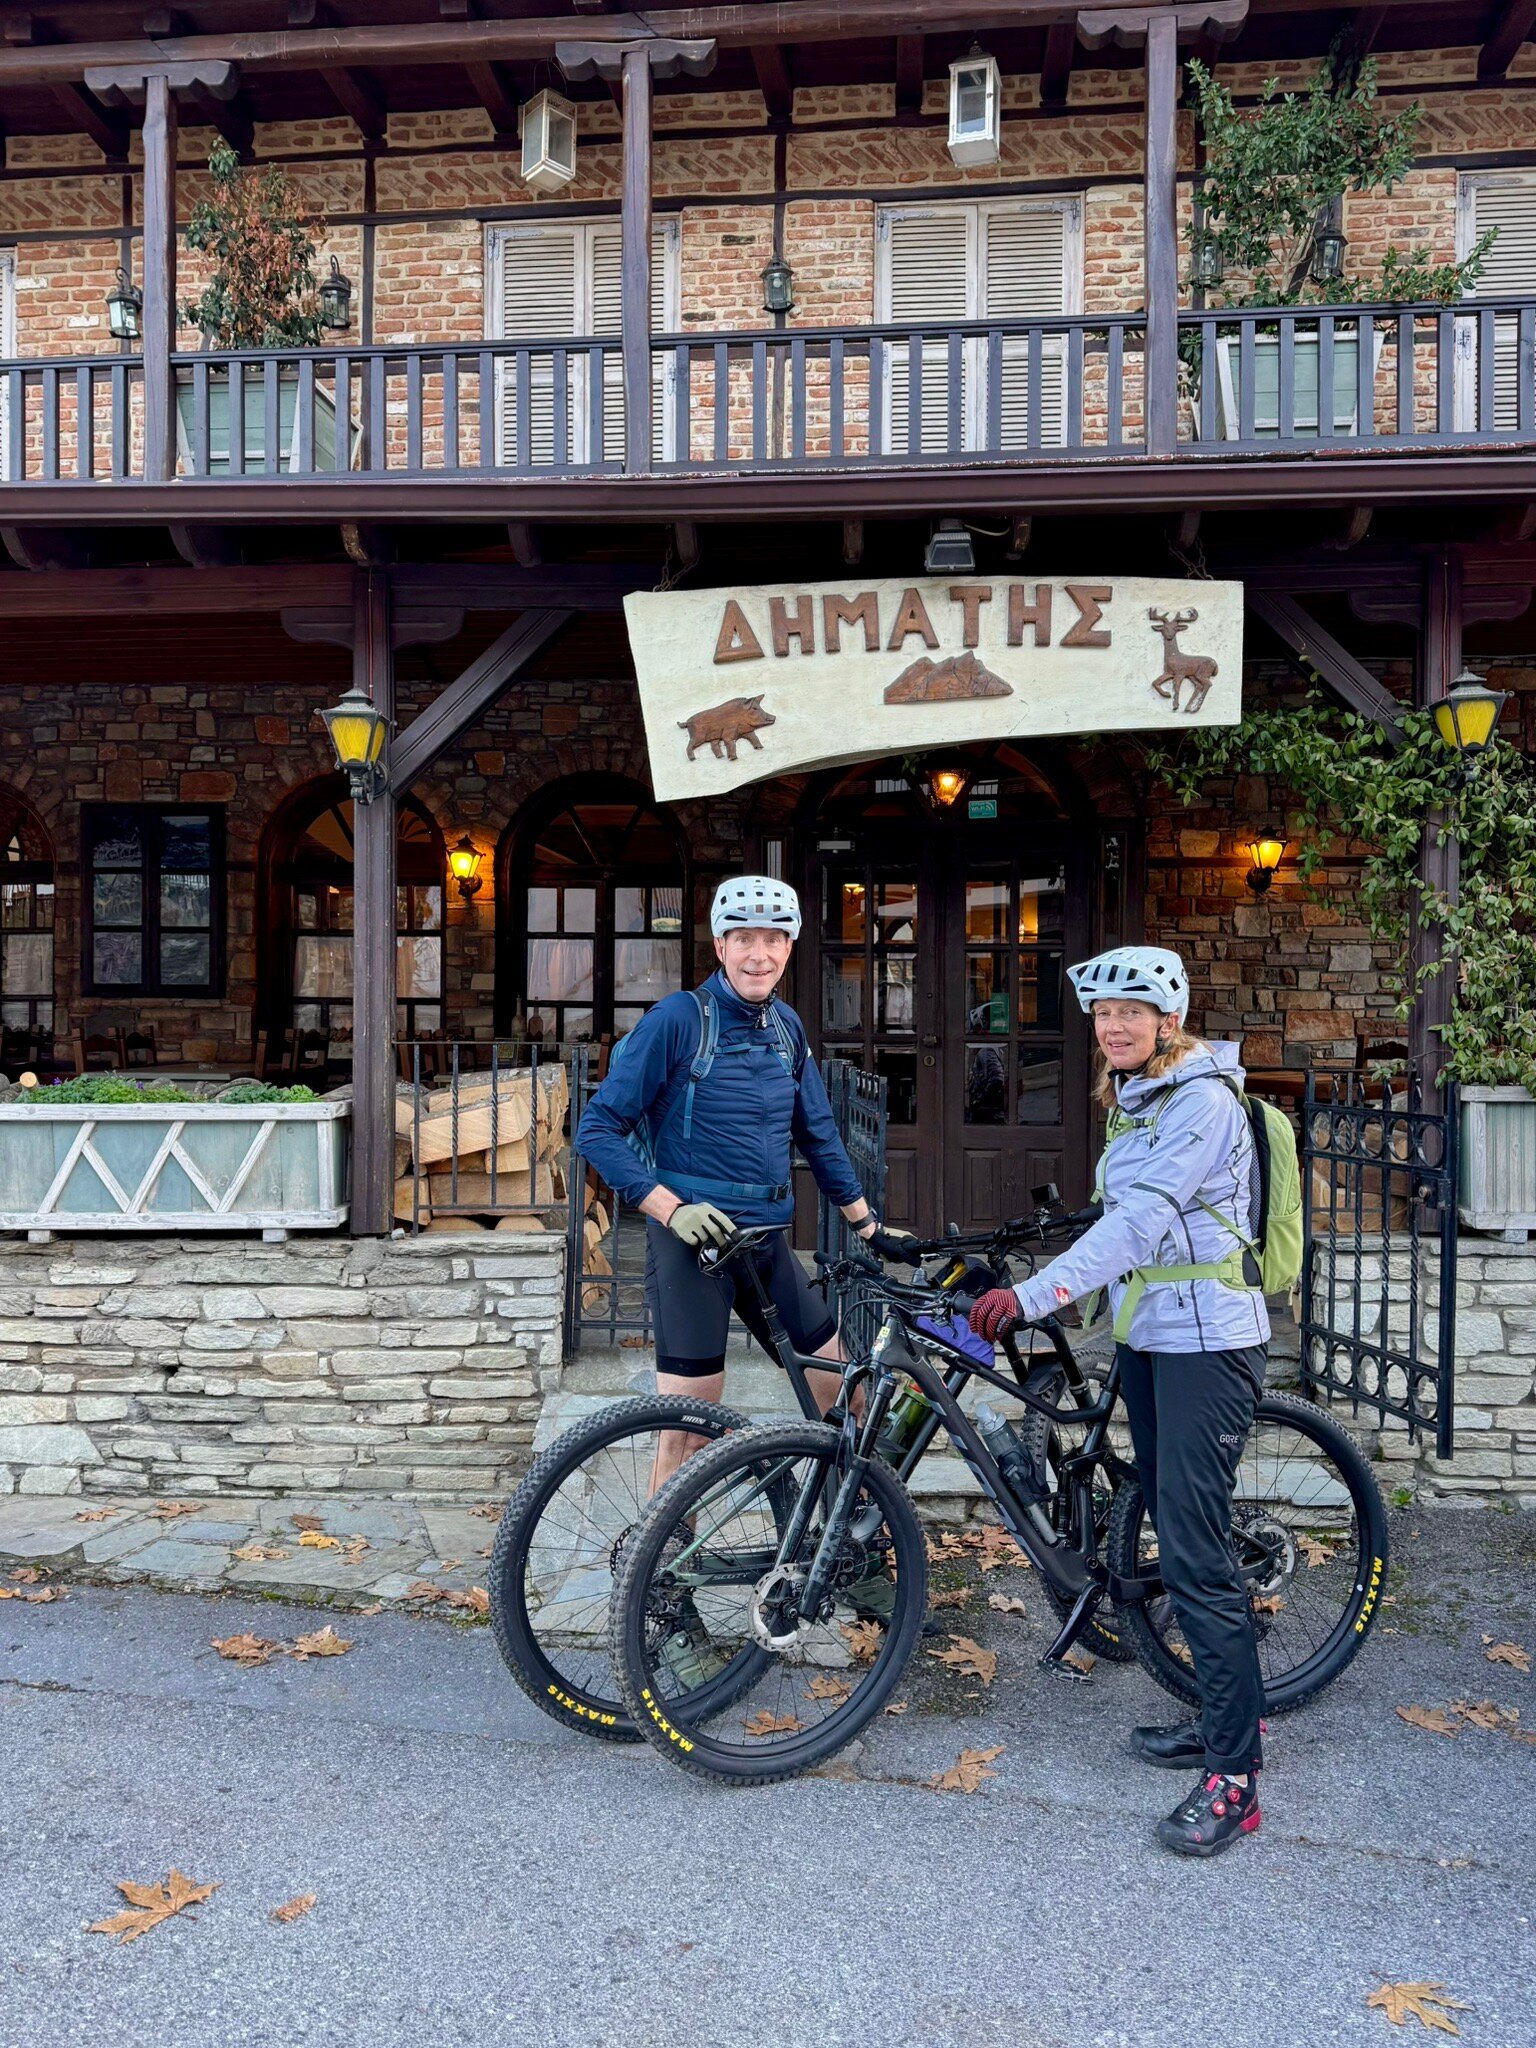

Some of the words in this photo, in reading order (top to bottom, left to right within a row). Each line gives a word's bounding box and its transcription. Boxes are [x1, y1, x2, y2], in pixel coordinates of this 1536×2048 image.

[712, 583, 1113, 664] ΔΗΜΑΤΗΣ
[1219, 1434, 1240, 1444] GORE
[1355, 1556, 1384, 1633] MAXXIS
[547, 1684, 616, 1726] MAXXIS
[641, 1688, 694, 1752] MAXXIS
